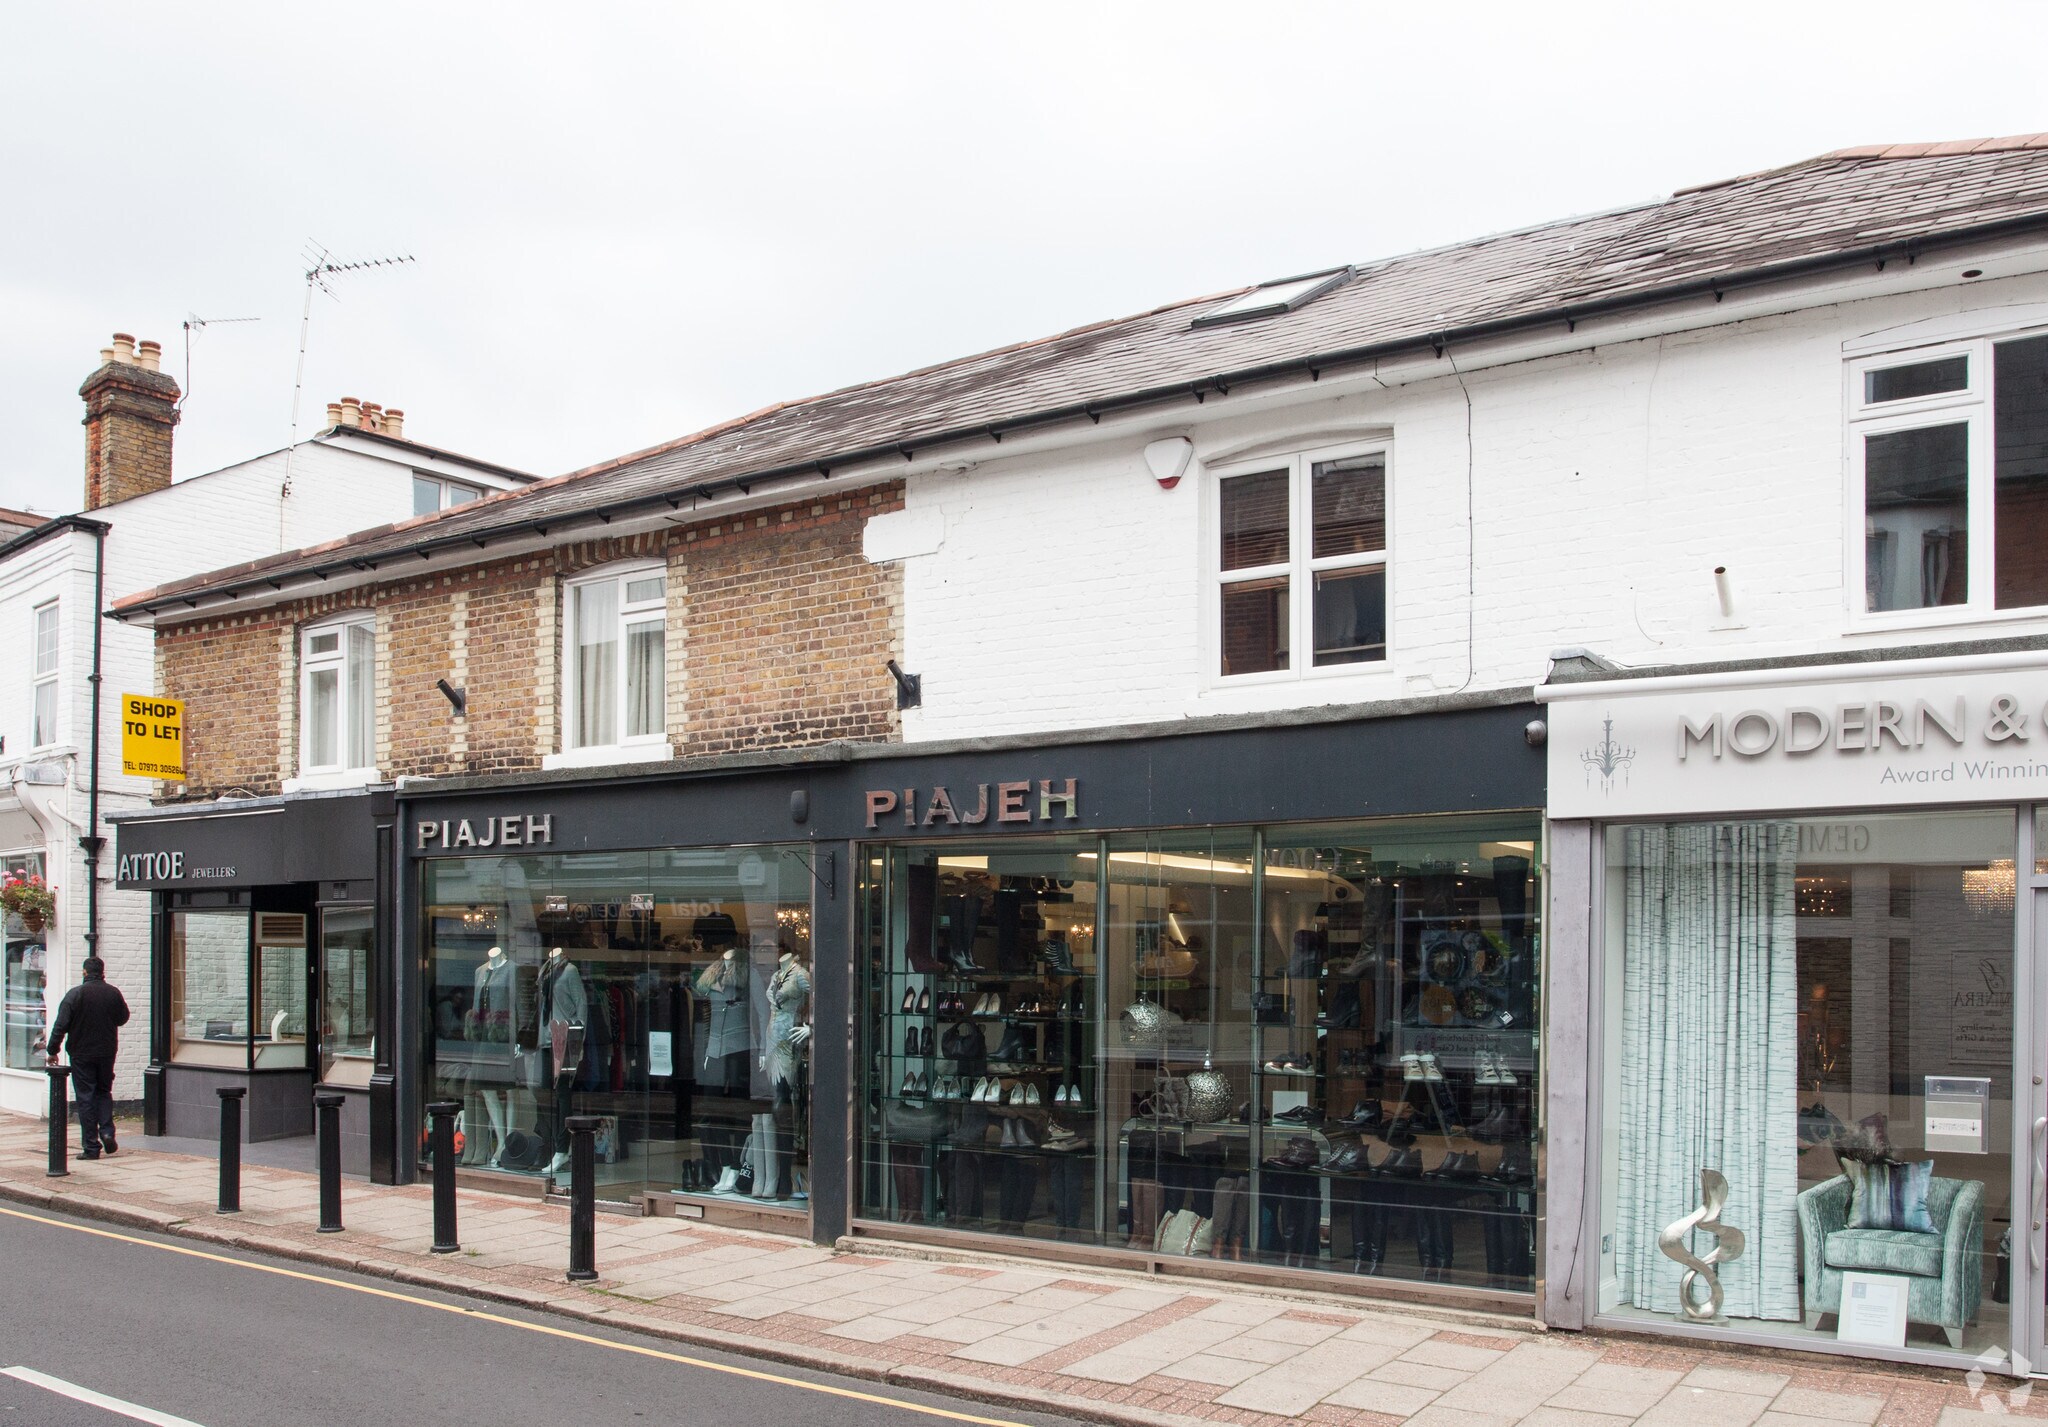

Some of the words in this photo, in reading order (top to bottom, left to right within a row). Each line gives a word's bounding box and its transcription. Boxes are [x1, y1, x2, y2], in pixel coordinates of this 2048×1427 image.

[130, 701, 177, 718] SHOP
[125, 721, 147, 736] TO
[154, 724, 181, 740] LET
[1677, 695, 1966, 760] MODERN
[1984, 693, 2030, 742] &
[124, 761, 136, 770] TEL:
[1880, 762, 1954, 784] Award
[1964, 759, 2048, 779] Winnin
[865, 778, 1079, 828] PIAJEH
[417, 814, 553, 849] PIAJEH
[118, 851, 185, 880] ATTOE
[192, 866, 237, 879] JEWELLERS
